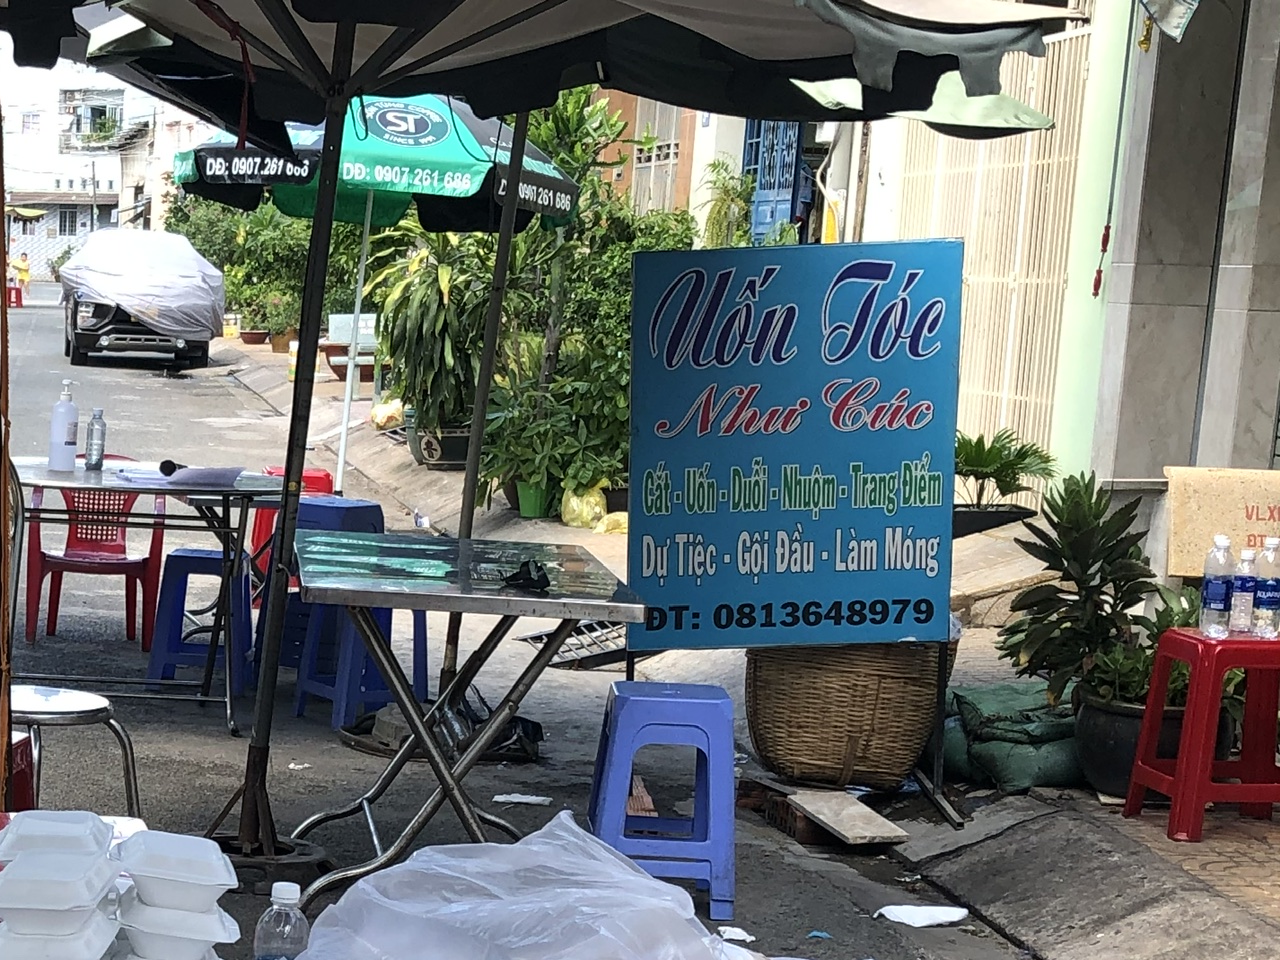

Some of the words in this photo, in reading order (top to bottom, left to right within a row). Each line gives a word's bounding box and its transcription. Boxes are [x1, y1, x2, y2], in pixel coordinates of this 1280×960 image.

[386, 112, 421, 132] ST
[206, 158, 228, 176] DĐ:
[232, 158, 284, 176] 0907.261
[342, 162, 370, 180] DĐ:
[374, 165, 438, 187] 0907.261
[444, 172, 472, 190] 686
[556, 192, 571, 212] 686
[649, 264, 799, 370] Uốn
[821, 259, 946, 365] Tóc
[655, 383, 812, 438] Như
[822, 377, 934, 433] Cúc
[643, 460, 672, 516] Cắt
[684, 462, 716, 514] Uốn
[730, 457, 768, 512] Duỗi
[781, 464, 836, 520] Nhuộm
[850, 462, 898, 516] Trang
[900, 450, 942, 507] Điểm
[1245, 505, 1280, 522] VLX
[642, 534, 670, 586] Dự
[674, 533, 717, 586] Tiệc
[737, 530, 769, 584] Gội
[776, 522, 814, 573] Đầu
[835, 528, 878, 572] Làm
[884, 526, 940, 578] Móng
[646, 605, 700, 631] ĐT:
[713, 598, 934, 629] 0813648979
